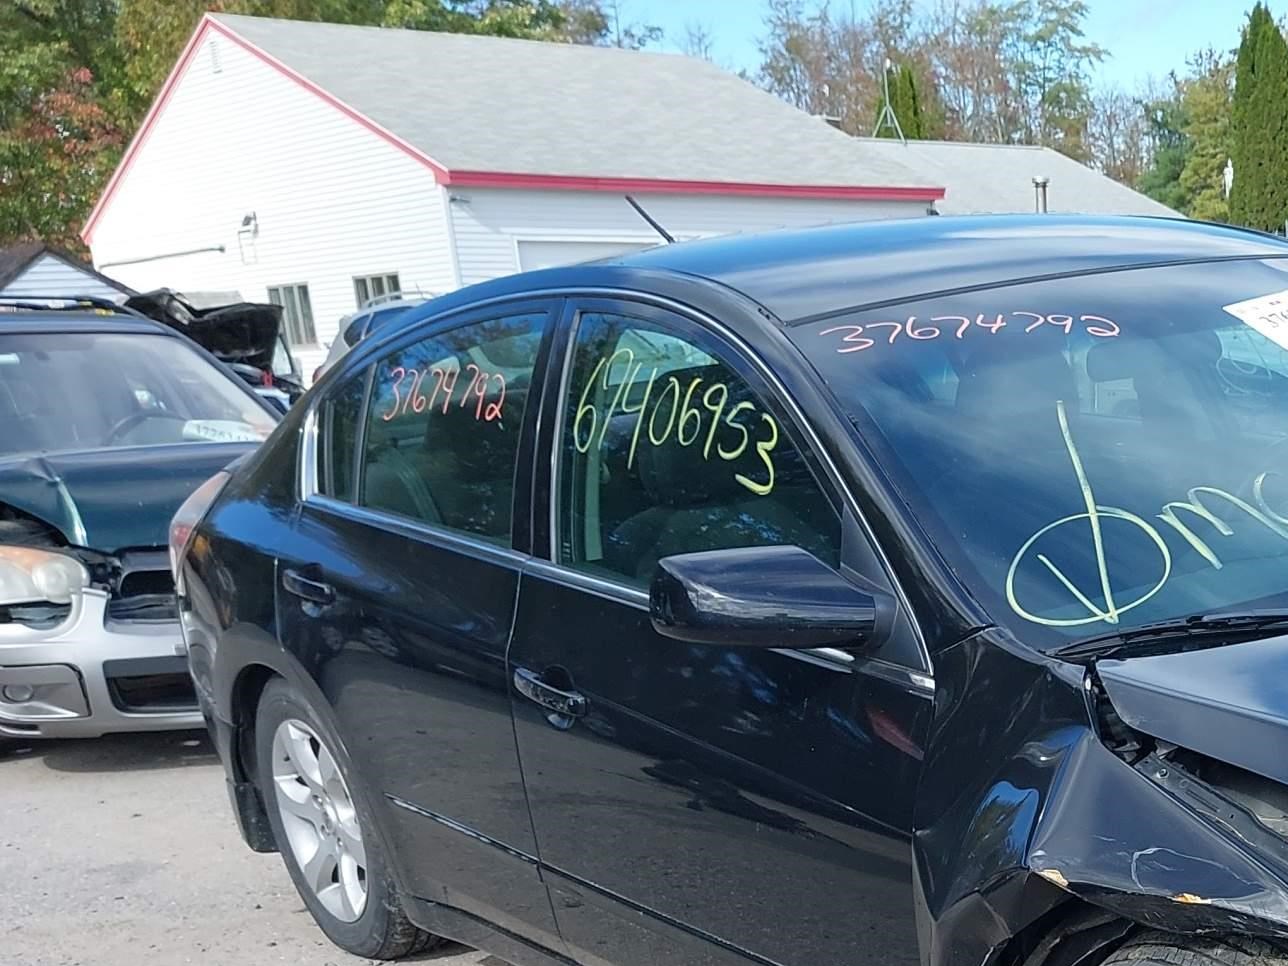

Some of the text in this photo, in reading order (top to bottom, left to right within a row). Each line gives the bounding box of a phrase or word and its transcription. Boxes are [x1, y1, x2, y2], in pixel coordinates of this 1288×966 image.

[818, 312, 1122, 353] 37674792
[383, 363, 507, 422] 37674792
[573, 348, 779, 496] 67406953
